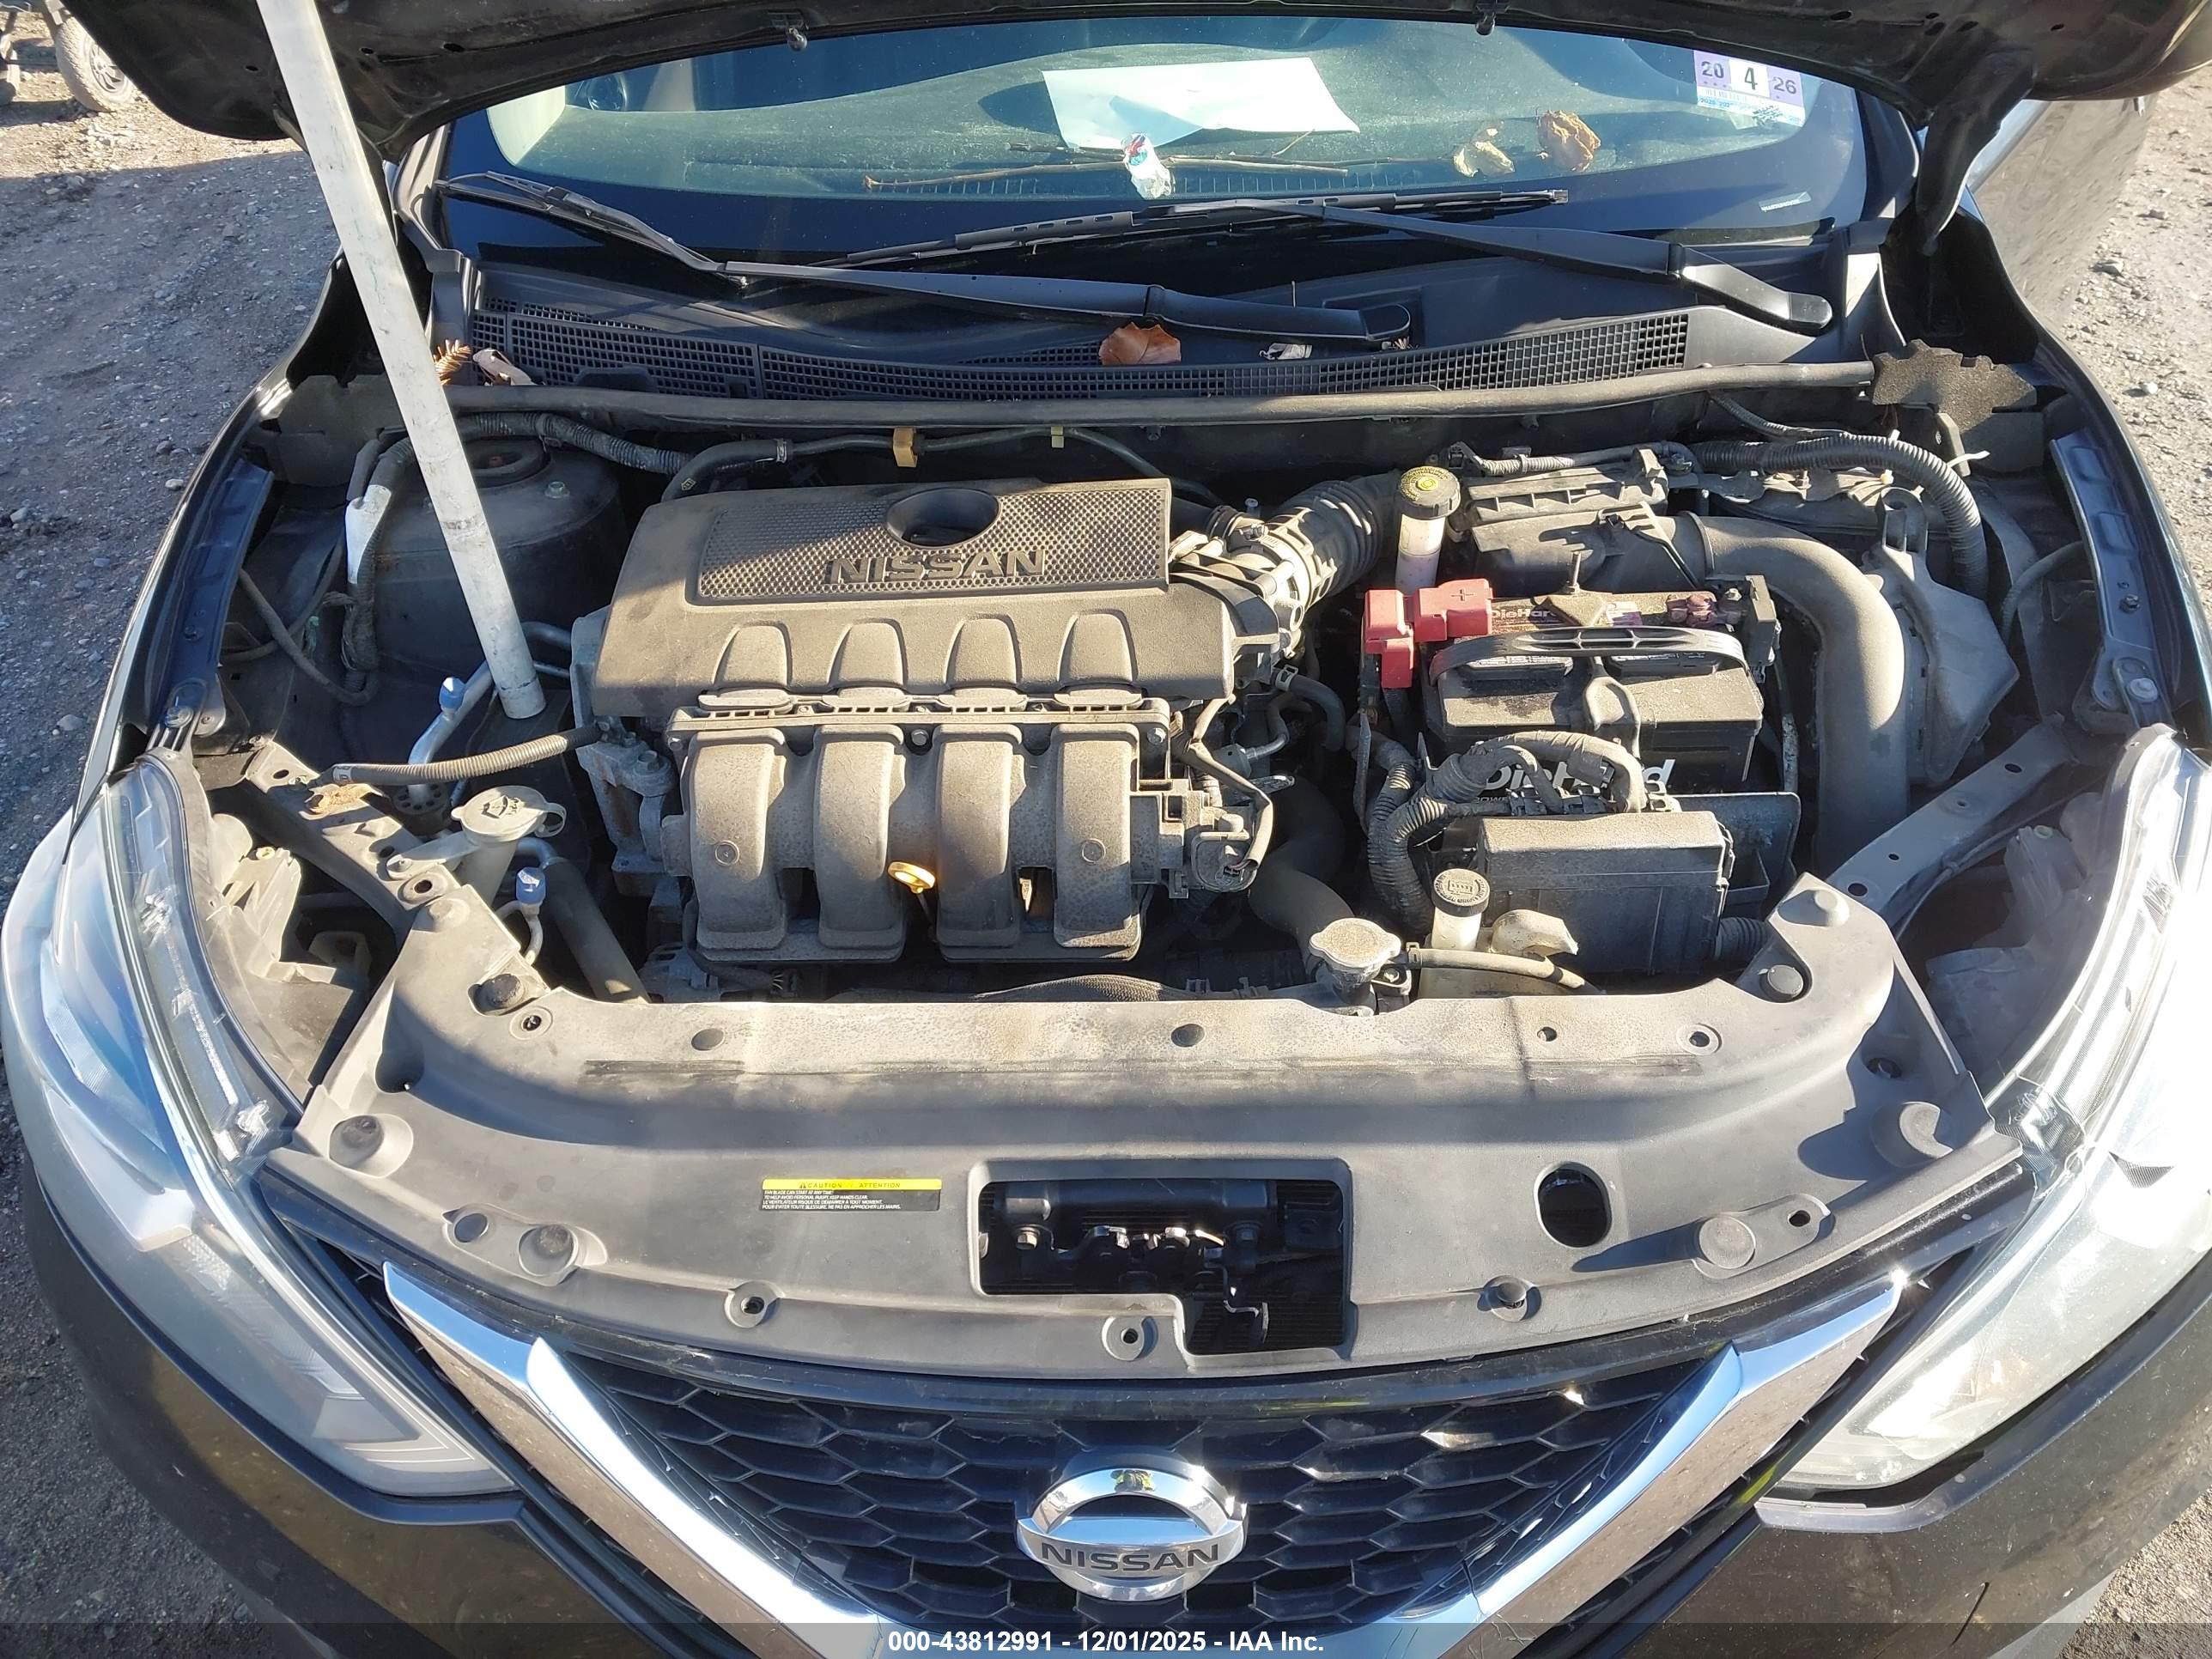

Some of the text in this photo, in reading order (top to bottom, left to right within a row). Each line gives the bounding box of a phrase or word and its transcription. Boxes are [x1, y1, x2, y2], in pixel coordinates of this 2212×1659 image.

[1701, 61, 1797, 94] 20 4 26
[825, 550, 1044, 584] NISSAN
[1491, 608, 1556, 618] DieHar
[1042, 1542, 1218, 1571] NISSAN
